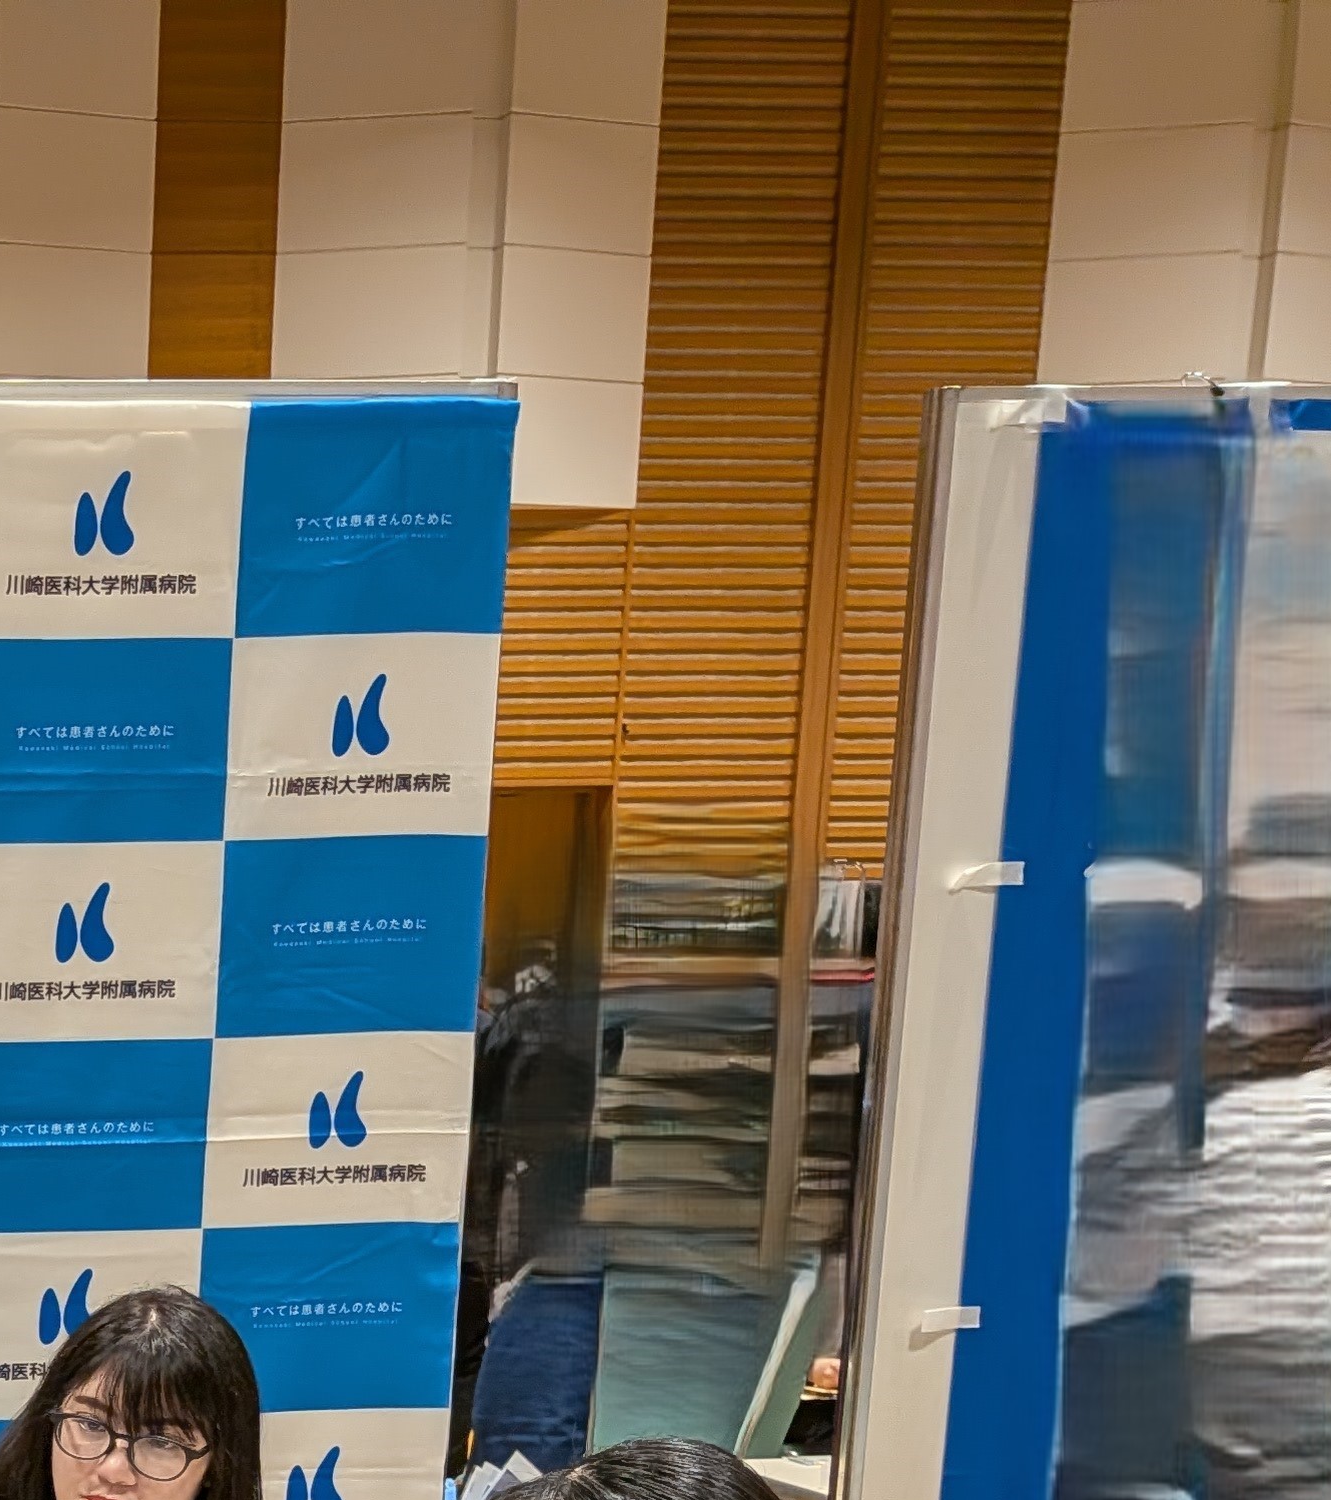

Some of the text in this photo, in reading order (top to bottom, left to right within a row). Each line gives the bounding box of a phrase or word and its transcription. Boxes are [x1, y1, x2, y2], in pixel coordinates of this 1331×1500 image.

[6, 575, 196, 596] 川崎医科大学附属病院
[15, 724, 175, 739] すべては患者さんのために
[267, 773, 451, 797] 川崎医科大学附属病院
[271, 918, 427, 935] すべては患者さんのために
[242, 1163, 426, 1187] 川崎医科大学附属病院
[249, 1301, 403, 1318] すべては患者さんのために
